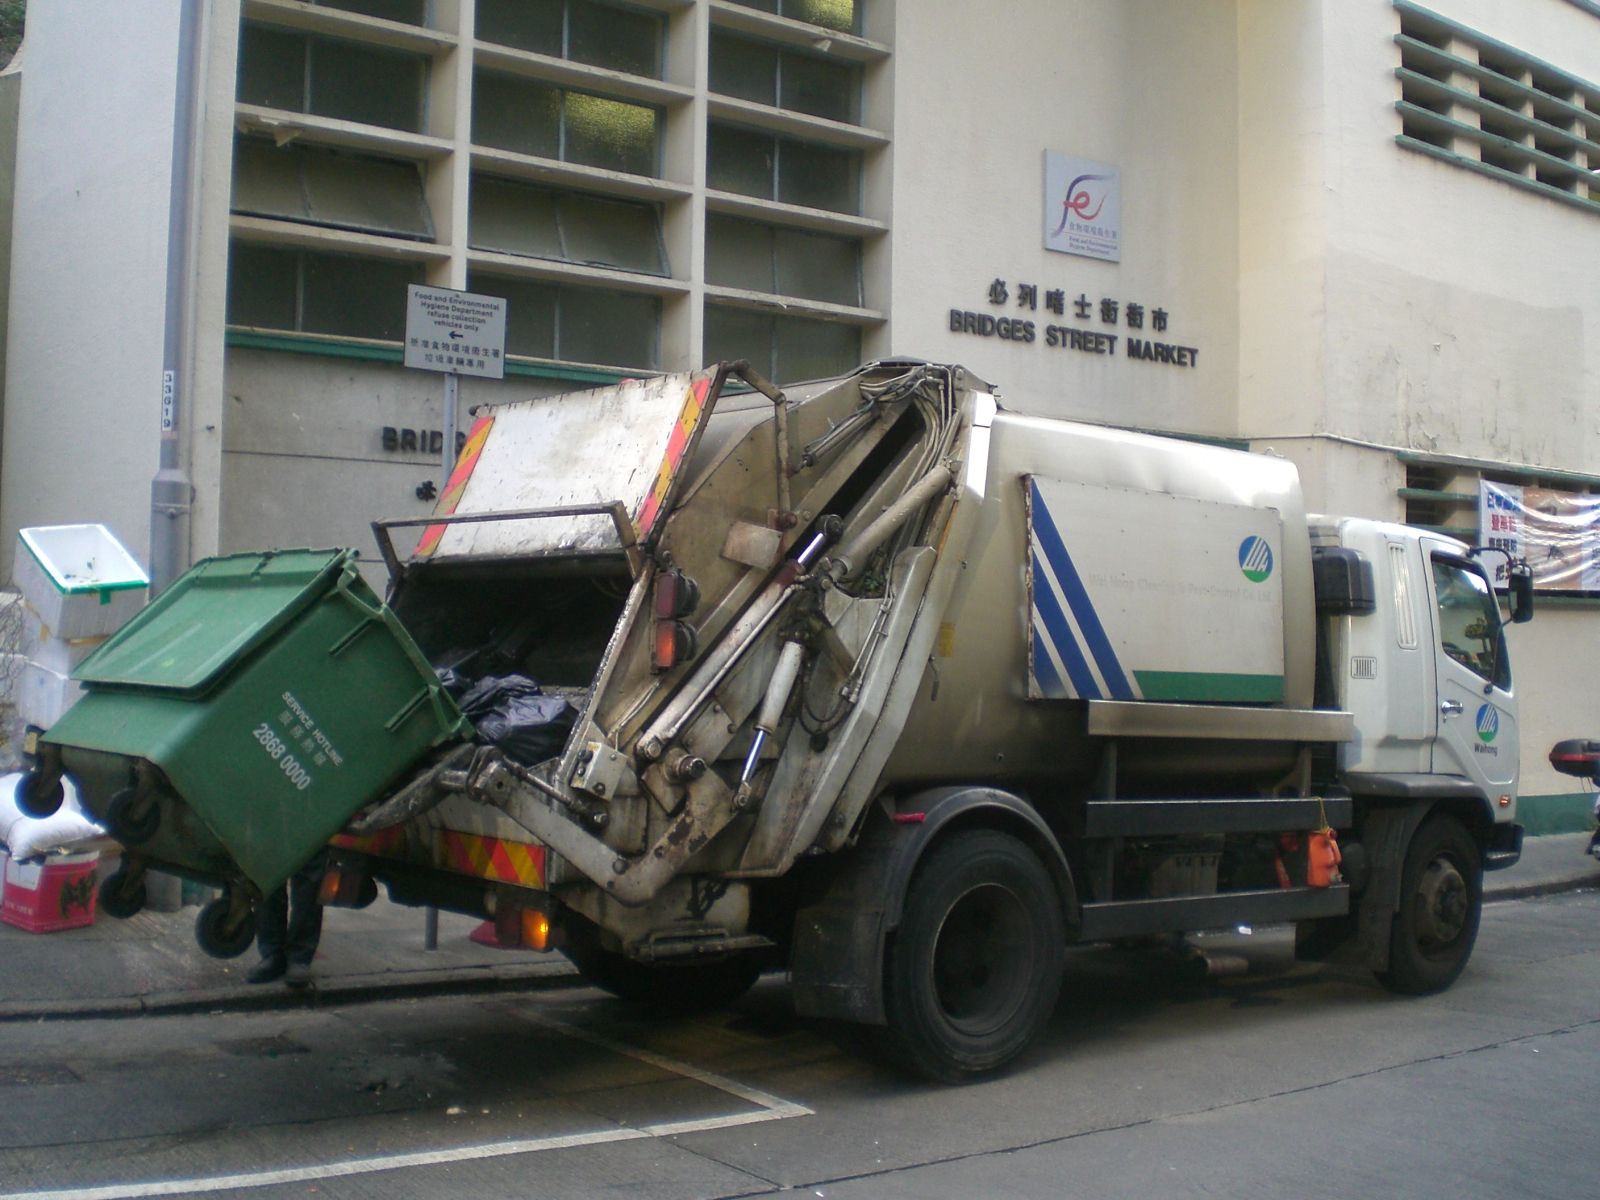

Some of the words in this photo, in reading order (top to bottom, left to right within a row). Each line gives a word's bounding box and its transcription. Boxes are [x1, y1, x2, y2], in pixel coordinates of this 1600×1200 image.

[414, 291, 433, 301] Food
[434, 294, 447, 303] and
[449, 296, 500, 311] Environmental
[420, 301, 450, 312] Hygiene
[451, 305, 493, 318] Department
[427, 310, 450, 320] refuse
[451, 313, 486, 325] collection
[988, 277, 1169, 332] 必列啫士街街市
[433, 319, 462, 329] vehicles
[463, 323, 479, 332] only
[950, 309, 1036, 343] BRIDGES
[1046, 324, 1118, 355] STREET
[1127, 337, 1199, 368] MARKET
[282, 691, 314, 730] SERVICE
[312, 729, 343, 767] HOTLINE
[252, 722, 286, 759] 2868
[280, 754, 311, 790] 0000
